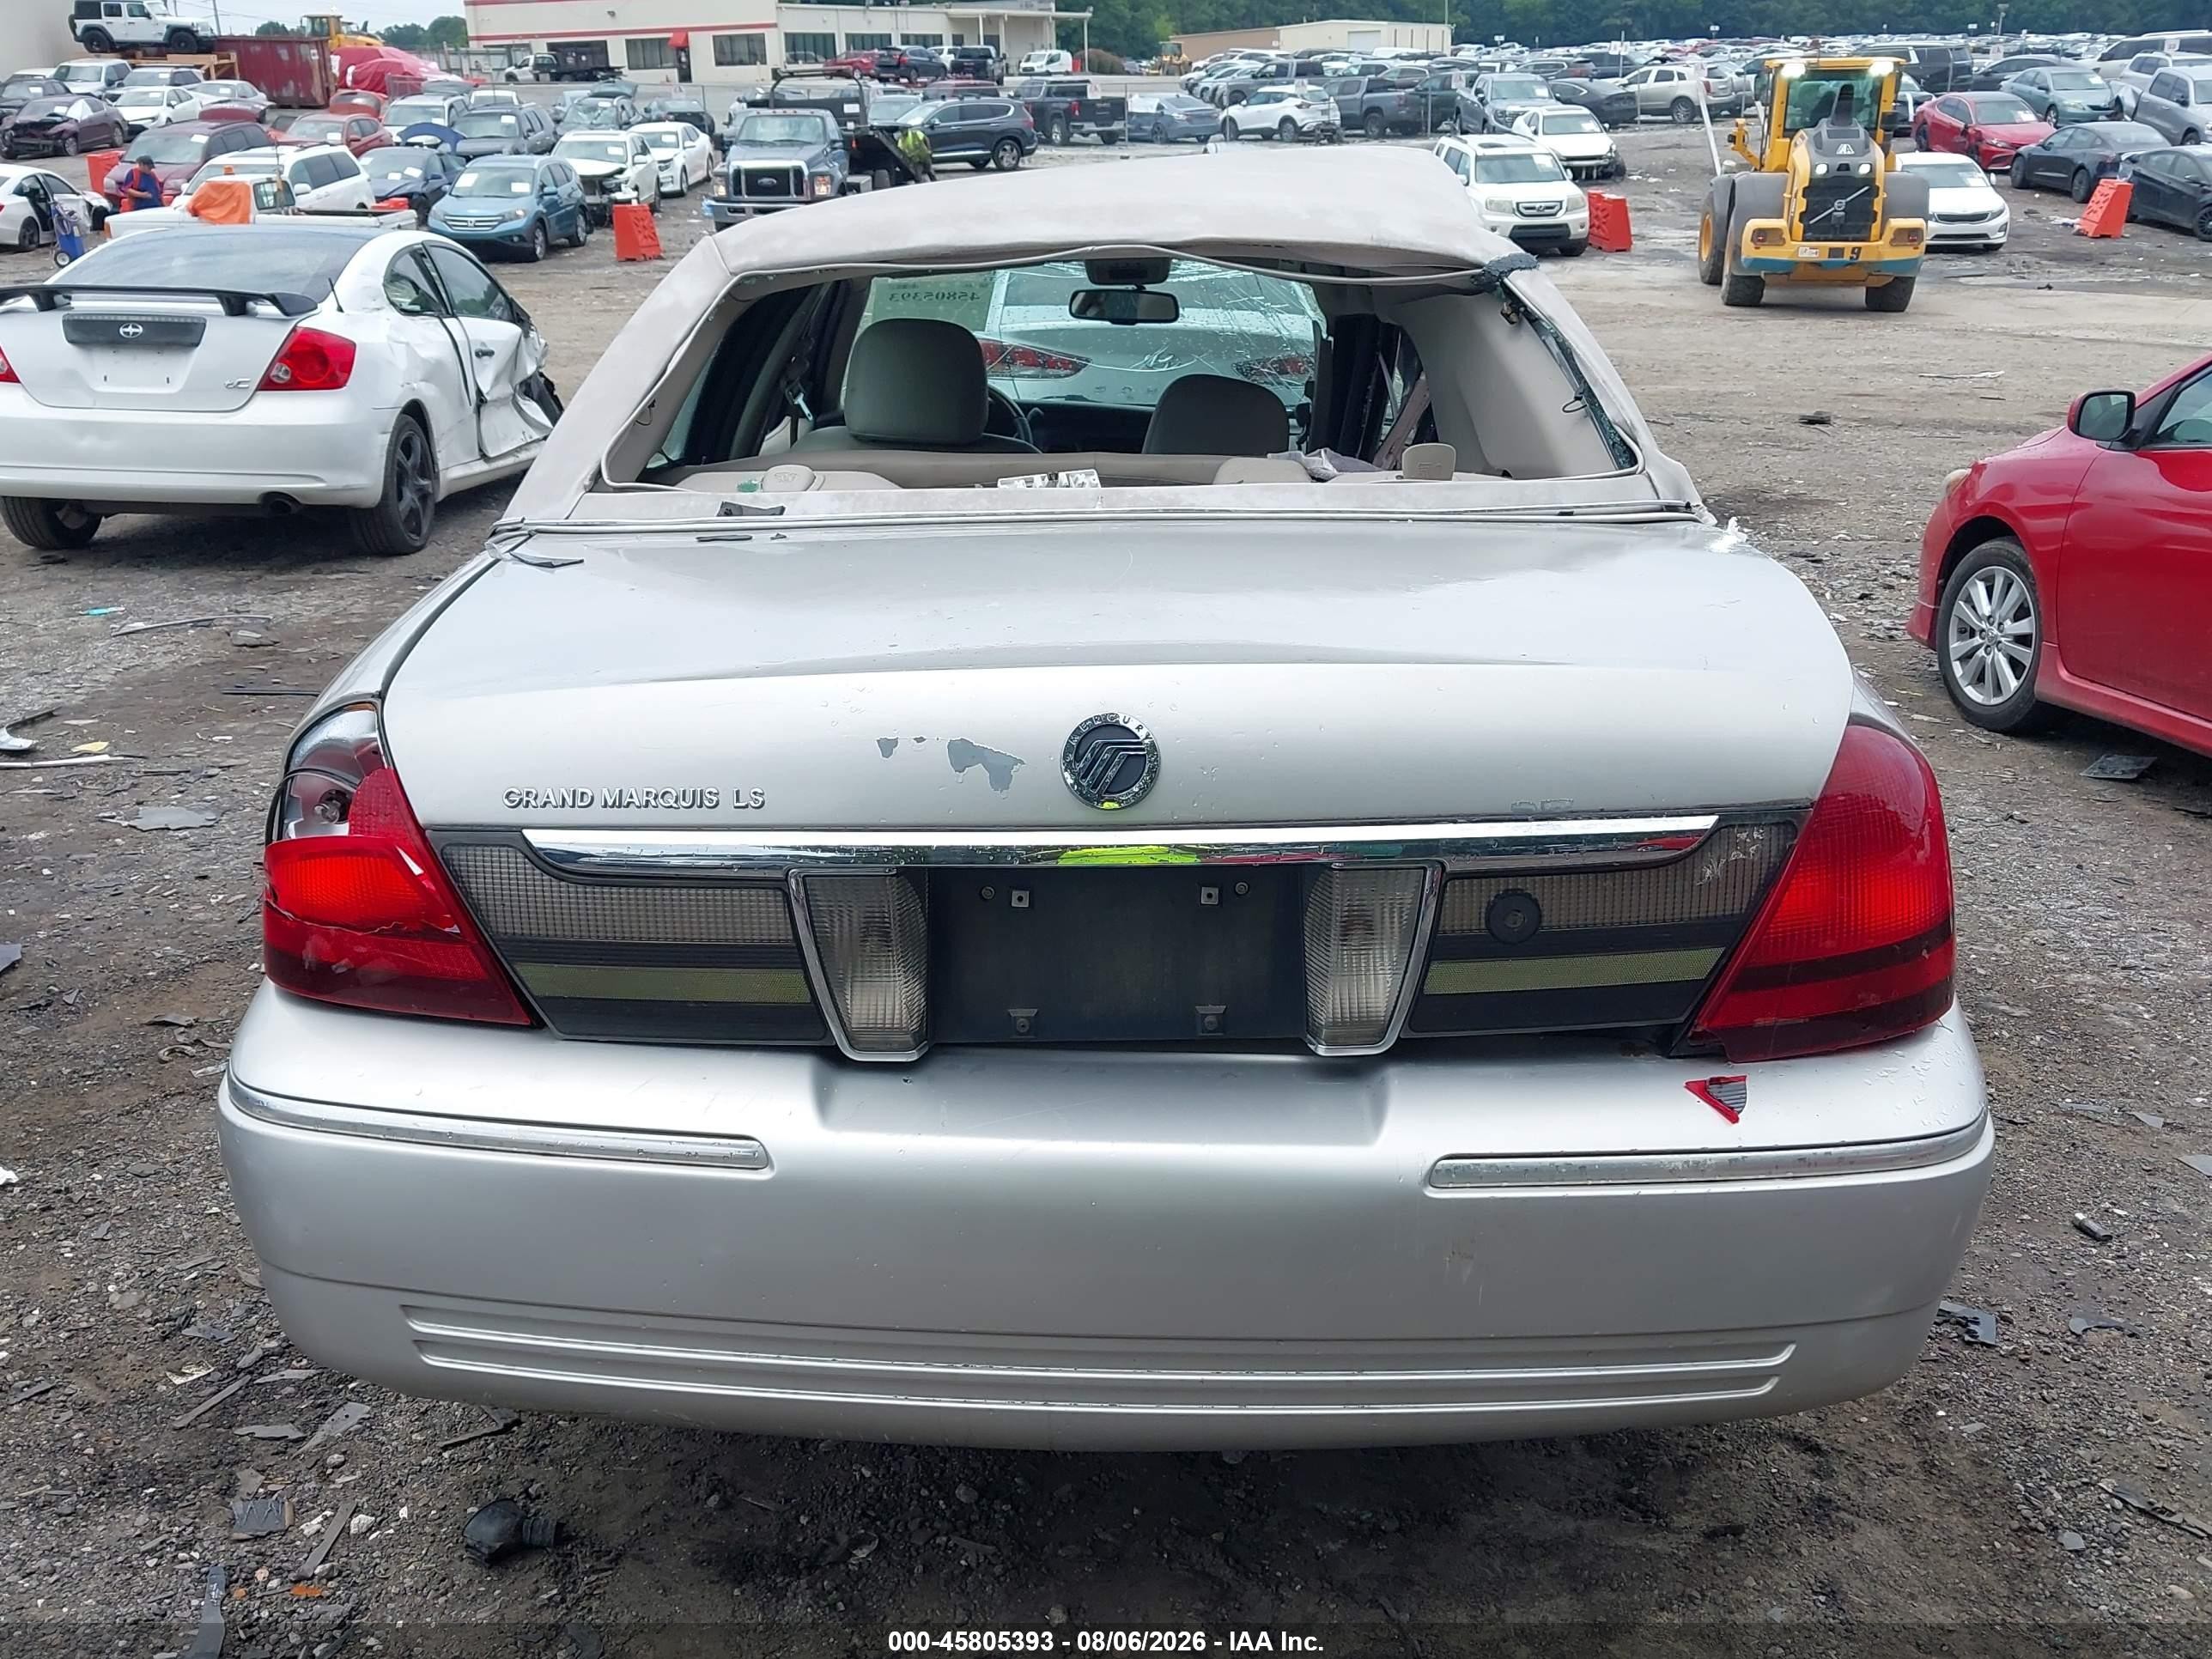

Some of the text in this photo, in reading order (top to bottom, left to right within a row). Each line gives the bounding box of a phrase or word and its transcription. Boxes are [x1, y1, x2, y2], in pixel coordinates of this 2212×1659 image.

[502, 786, 766, 809] GRAND MARQUIS LS
